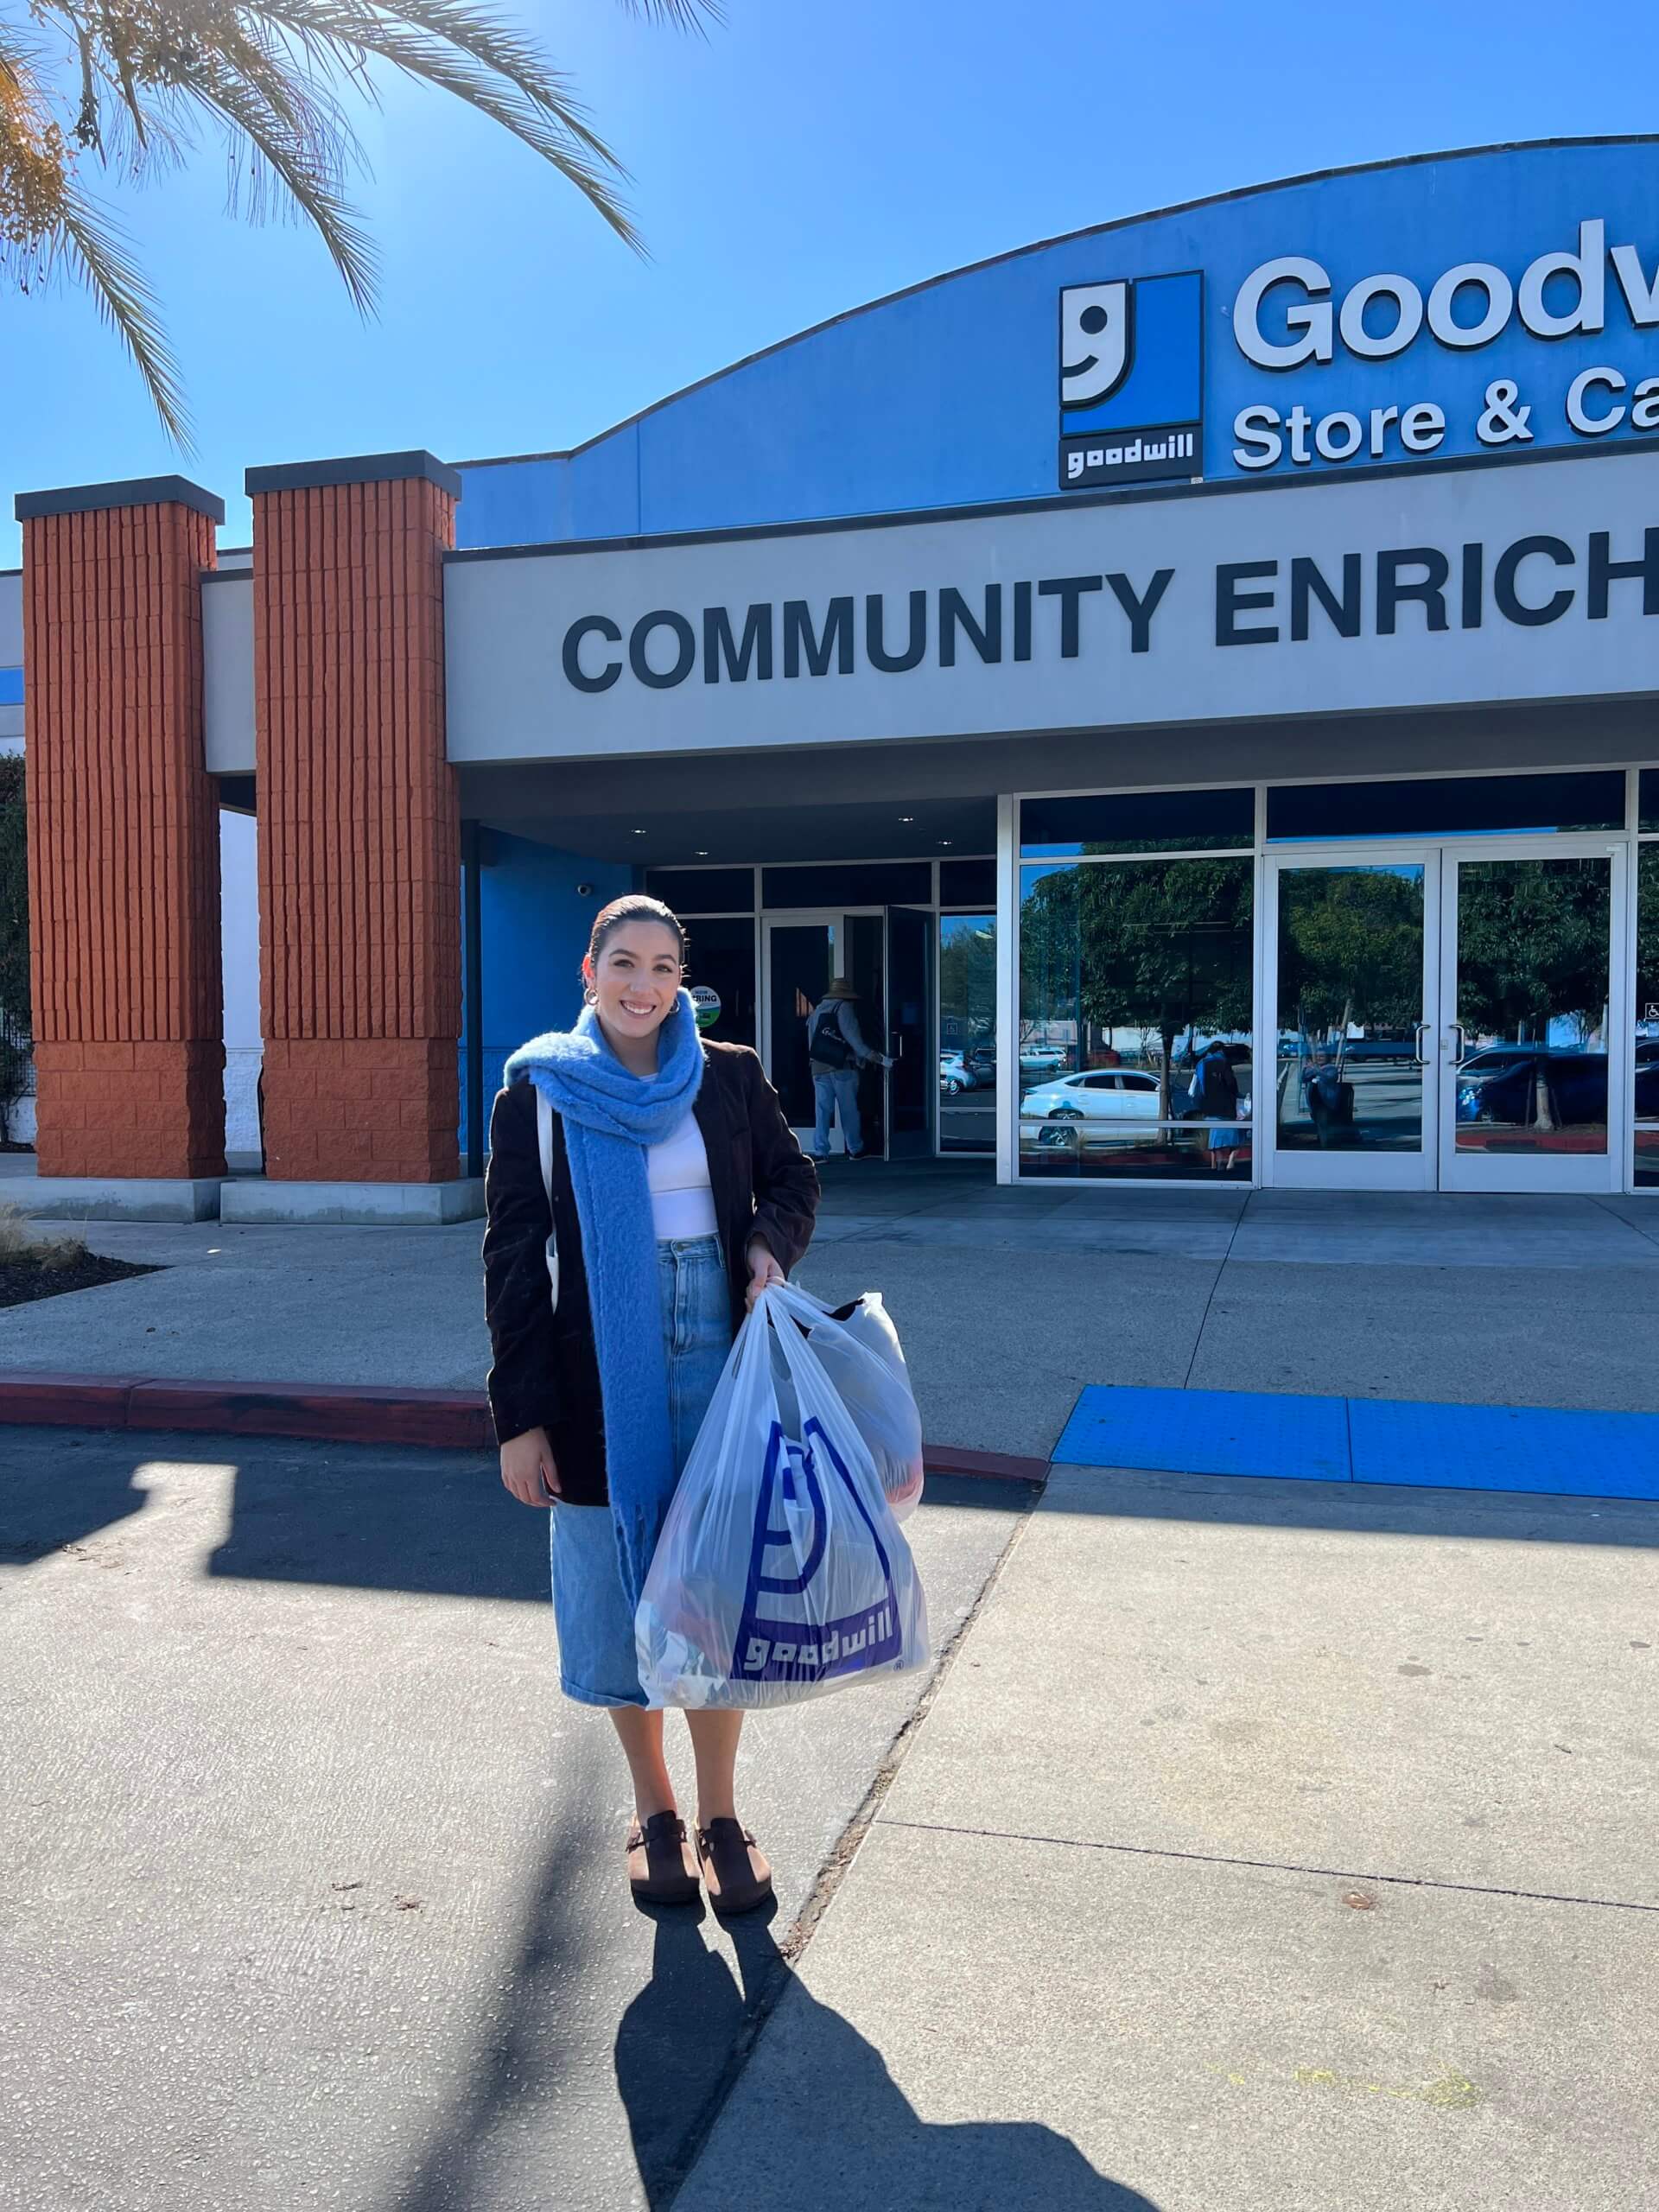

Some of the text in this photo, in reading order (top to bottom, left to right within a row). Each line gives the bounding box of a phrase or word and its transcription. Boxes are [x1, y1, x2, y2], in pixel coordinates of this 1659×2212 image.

[1068, 433, 1192, 479] goodwill
[1234, 402, 1446, 468] Store
[1477, 378, 1533, 443] &
[563, 527, 1659, 693] COMMUNITY ENRICH
[744, 1606, 893, 1670] goodwill
